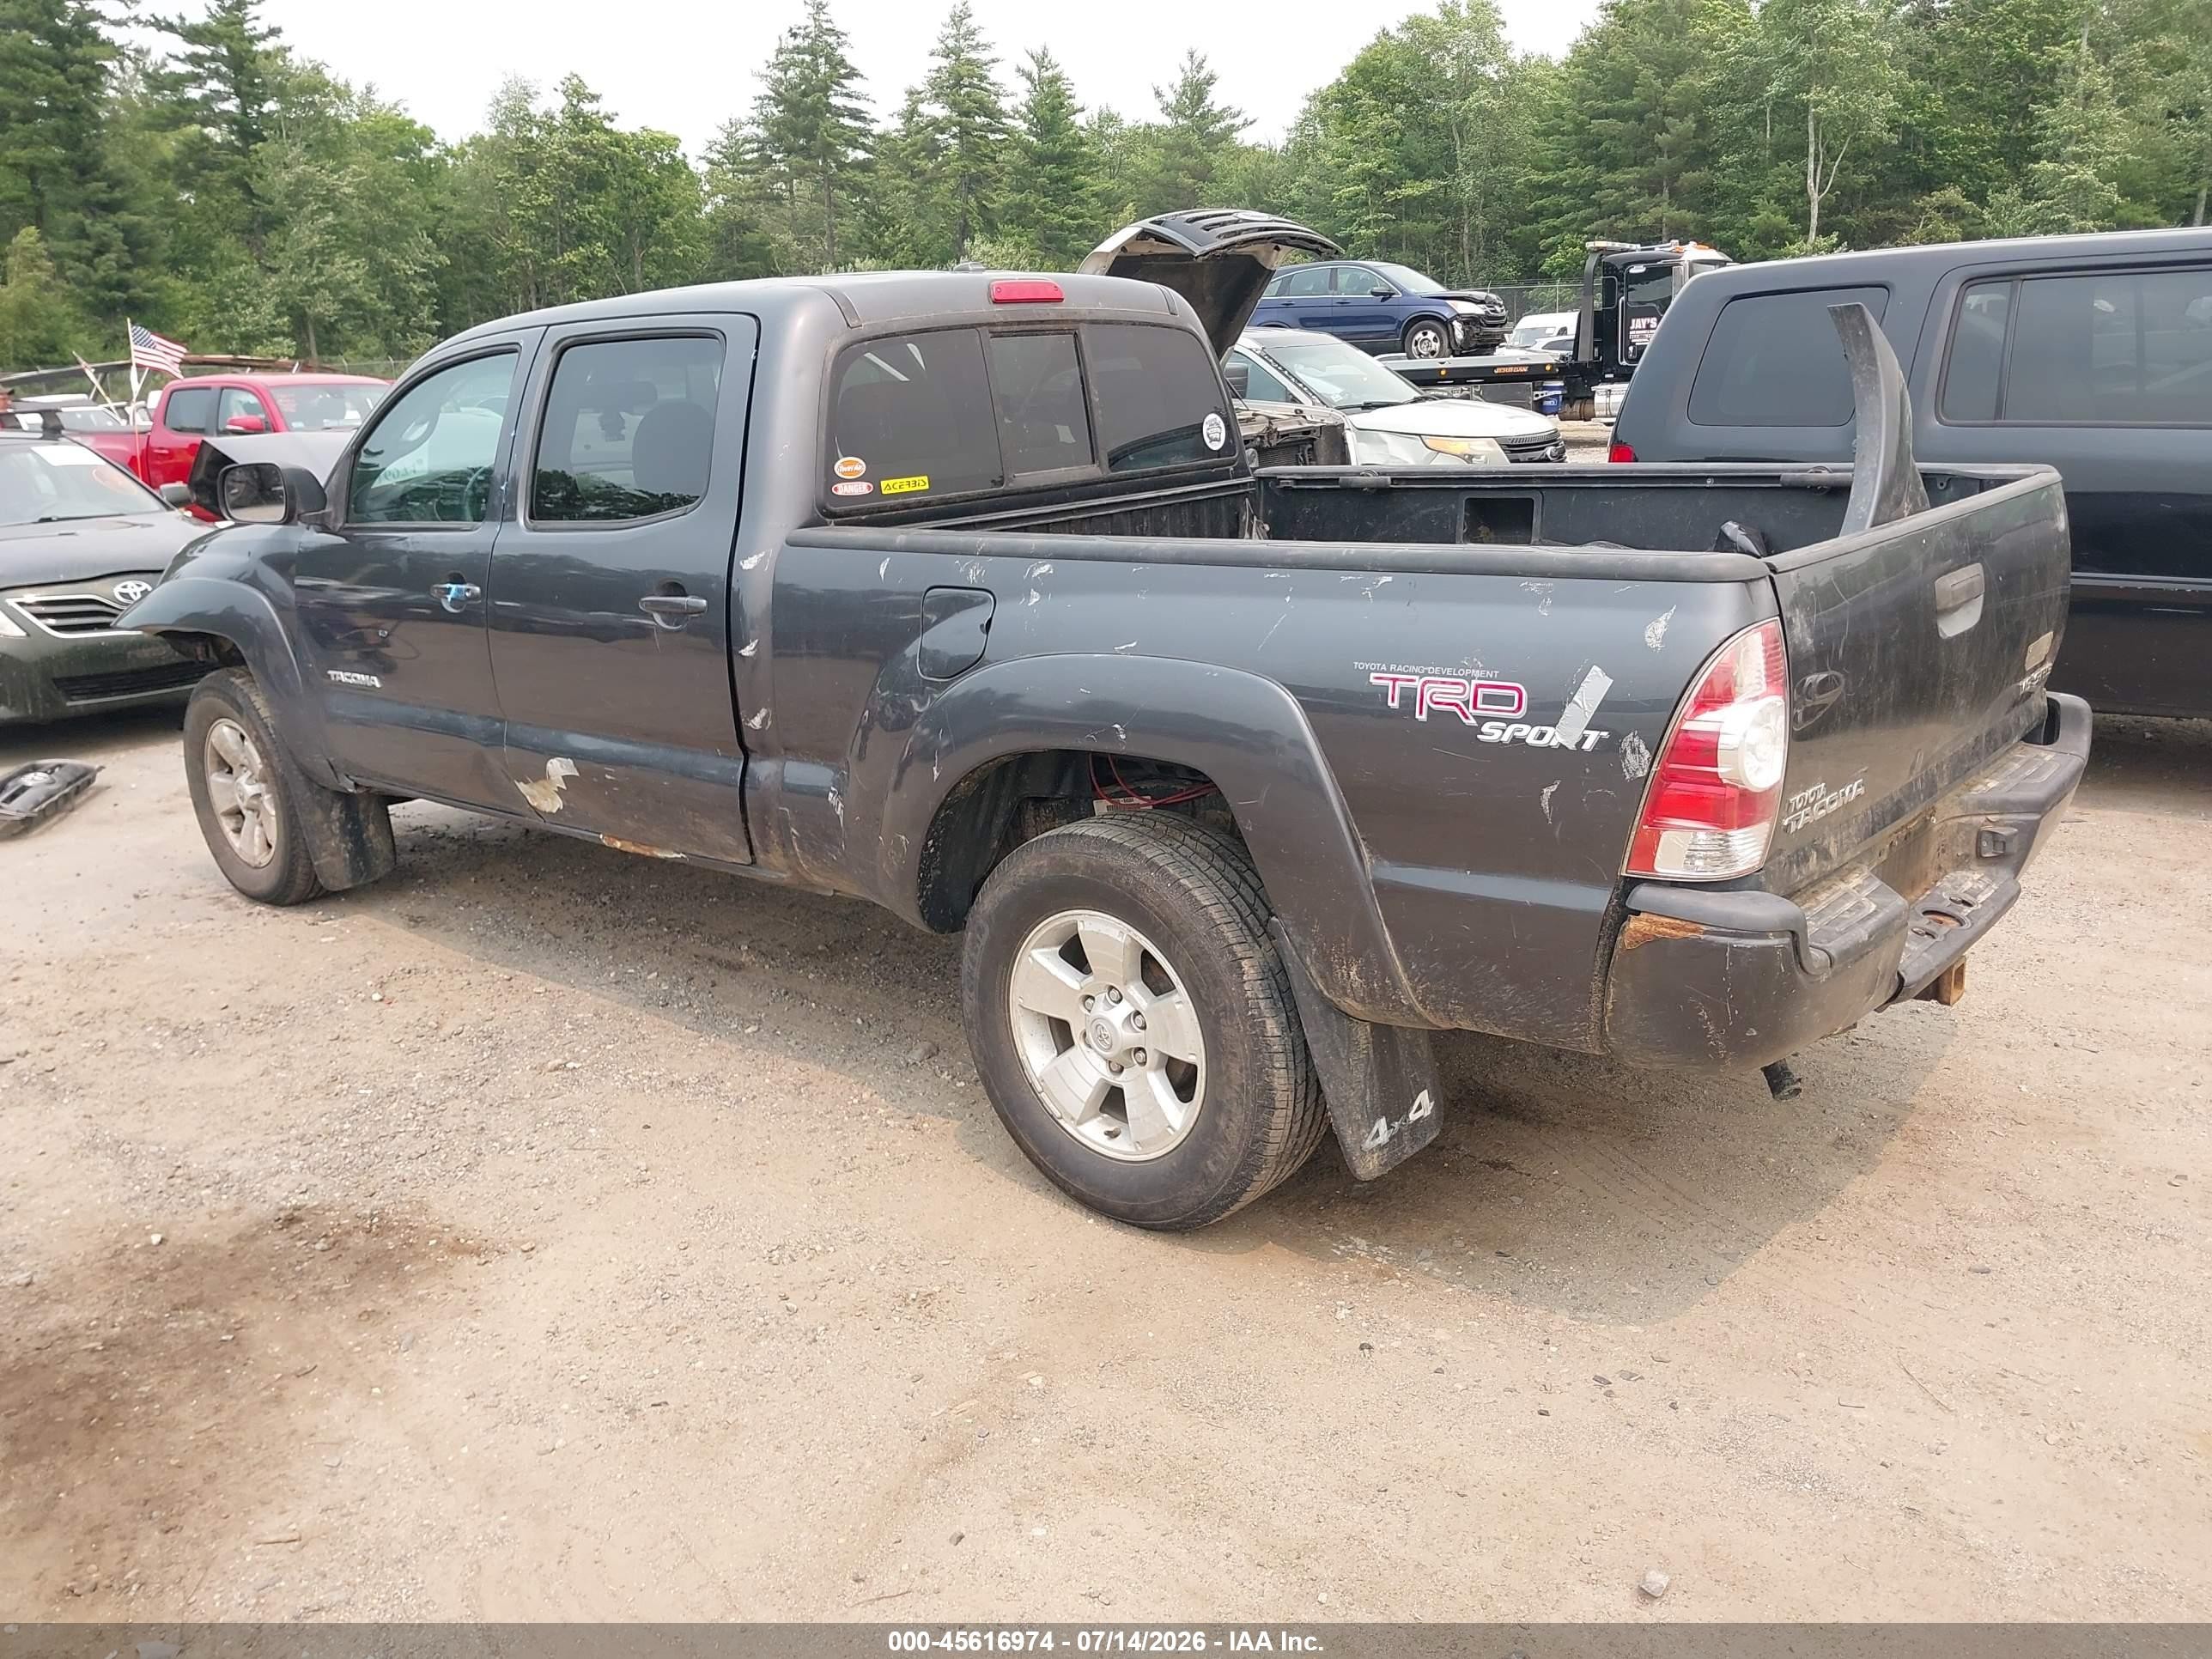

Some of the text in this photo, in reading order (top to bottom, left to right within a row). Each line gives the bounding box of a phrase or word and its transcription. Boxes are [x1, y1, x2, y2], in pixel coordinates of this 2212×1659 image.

[1630, 317, 1658, 330] JAY'S
[837, 484, 867, 495] DANGER
[883, 478, 927, 492] ACERBIS
[326, 669, 382, 689] TACOMA
[1353, 661, 1499, 679] TOYOTA RACING DEVELOPMENT
[1370, 672, 1528, 726] TRD
[1476, 720, 1611, 753] SPOT
[1782, 779, 1866, 835] TACOMA
